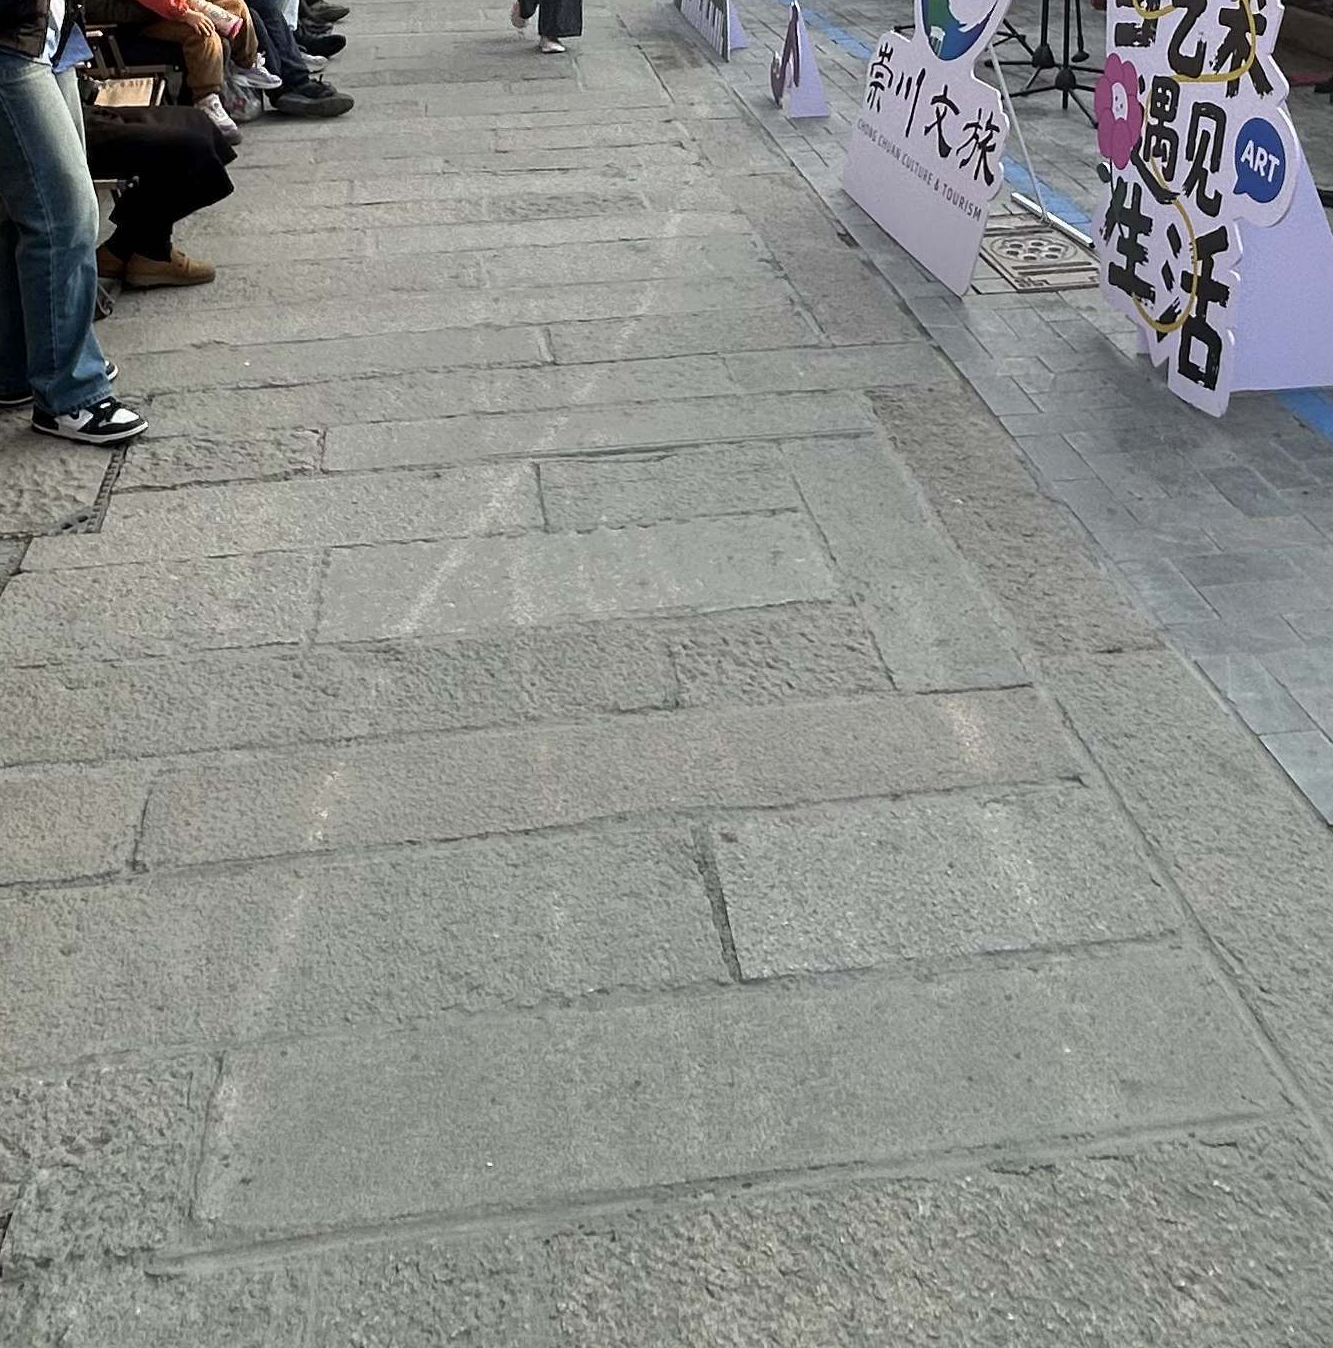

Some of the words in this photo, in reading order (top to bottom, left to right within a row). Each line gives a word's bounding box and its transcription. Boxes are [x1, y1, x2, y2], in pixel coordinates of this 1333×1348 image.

[856, 118, 877, 142] CHONG
[878, 134, 901, 160] CHUAN
[901, 153, 933, 186] CULTURE
[941, 183, 983, 222] TOURISM
[865, 42, 1002, 187] 崇川文旅
[1131, 75, 1228, 218] 遇见
[1240, 139, 1281, 183] ART
[1102, 175, 1230, 392] 生活
